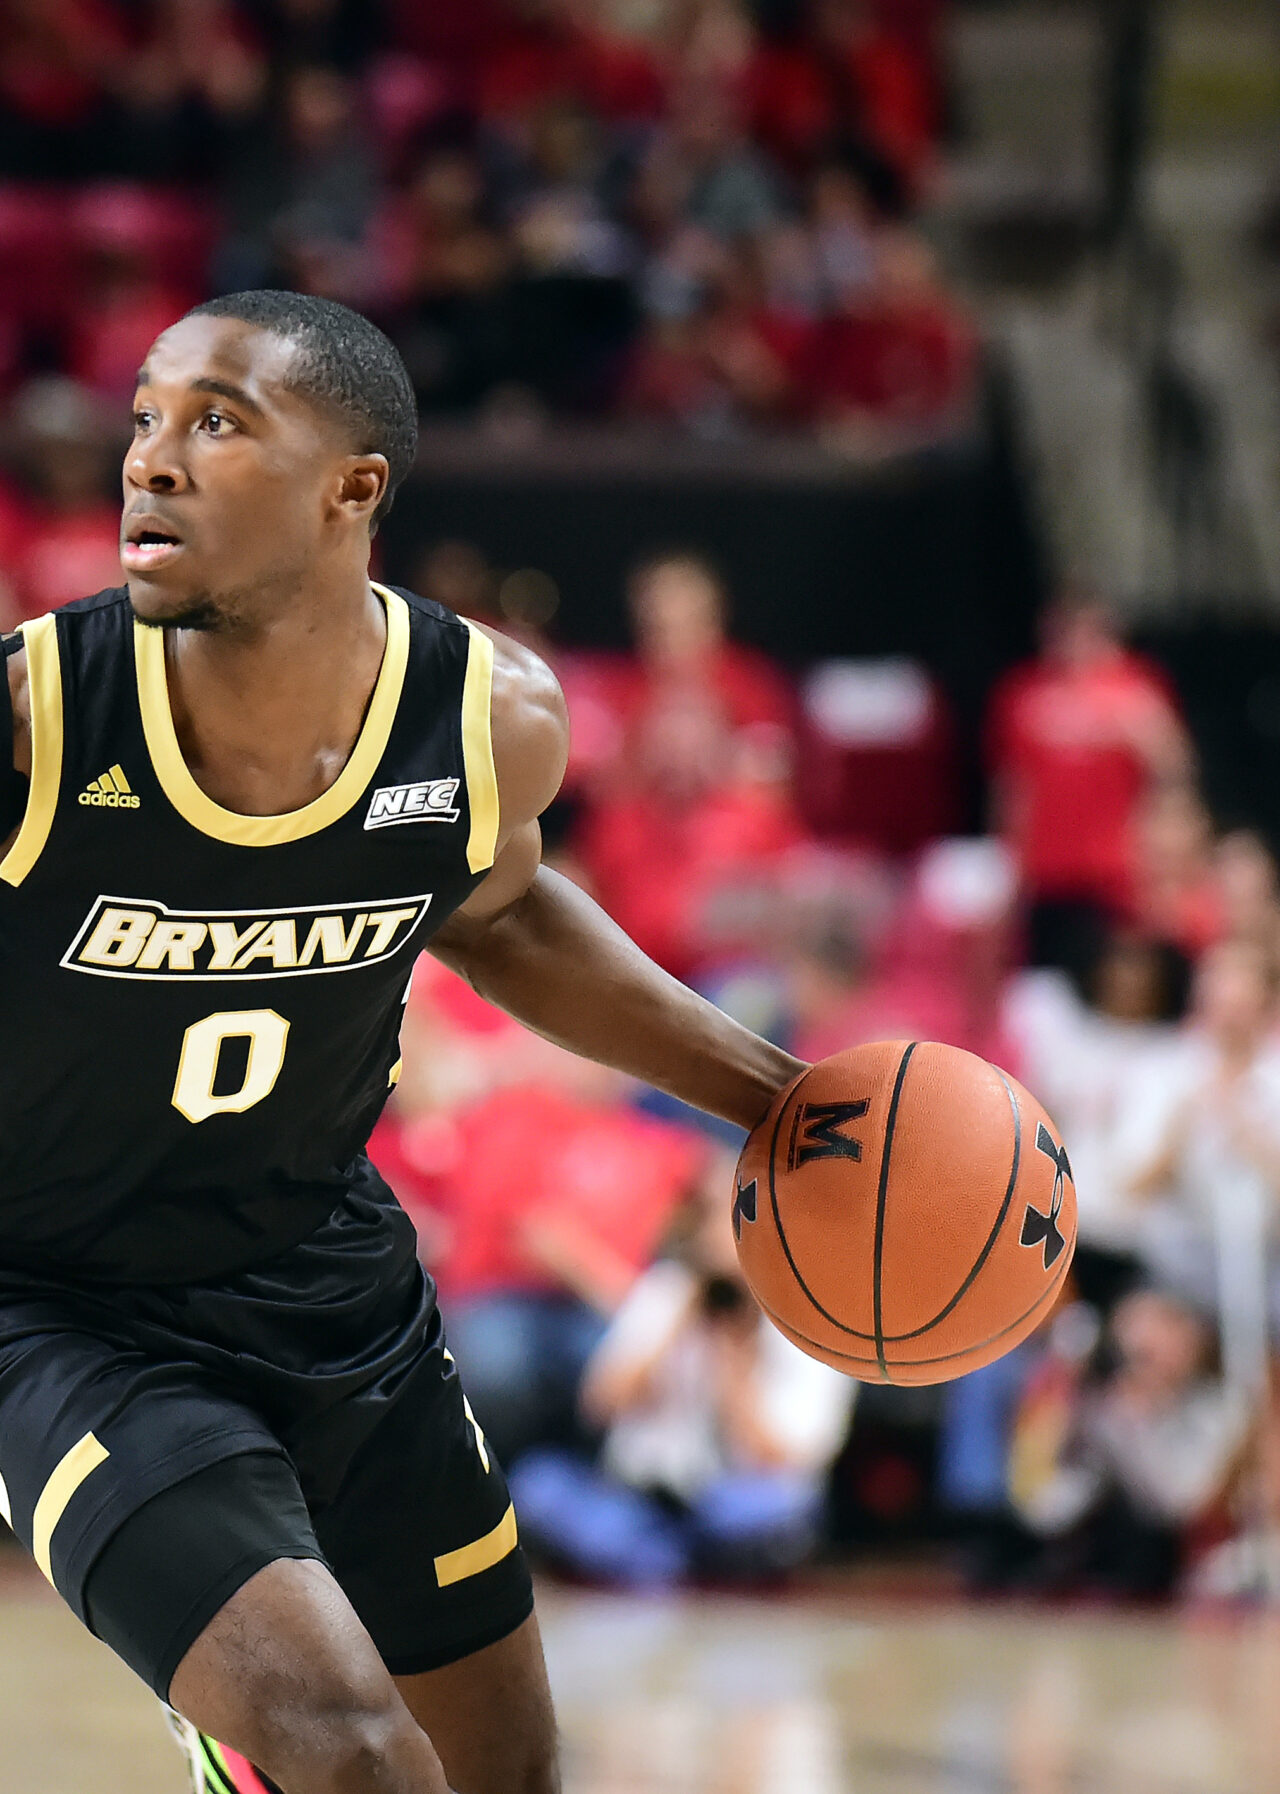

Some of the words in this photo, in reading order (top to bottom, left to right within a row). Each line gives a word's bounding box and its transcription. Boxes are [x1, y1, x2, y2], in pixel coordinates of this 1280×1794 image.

[78, 789, 141, 809] adidas
[370, 781, 457, 819] NEC
[77, 906, 419, 971] BRYANT
[171, 1008, 291, 1124] 0
[794, 1098, 871, 1170] M
